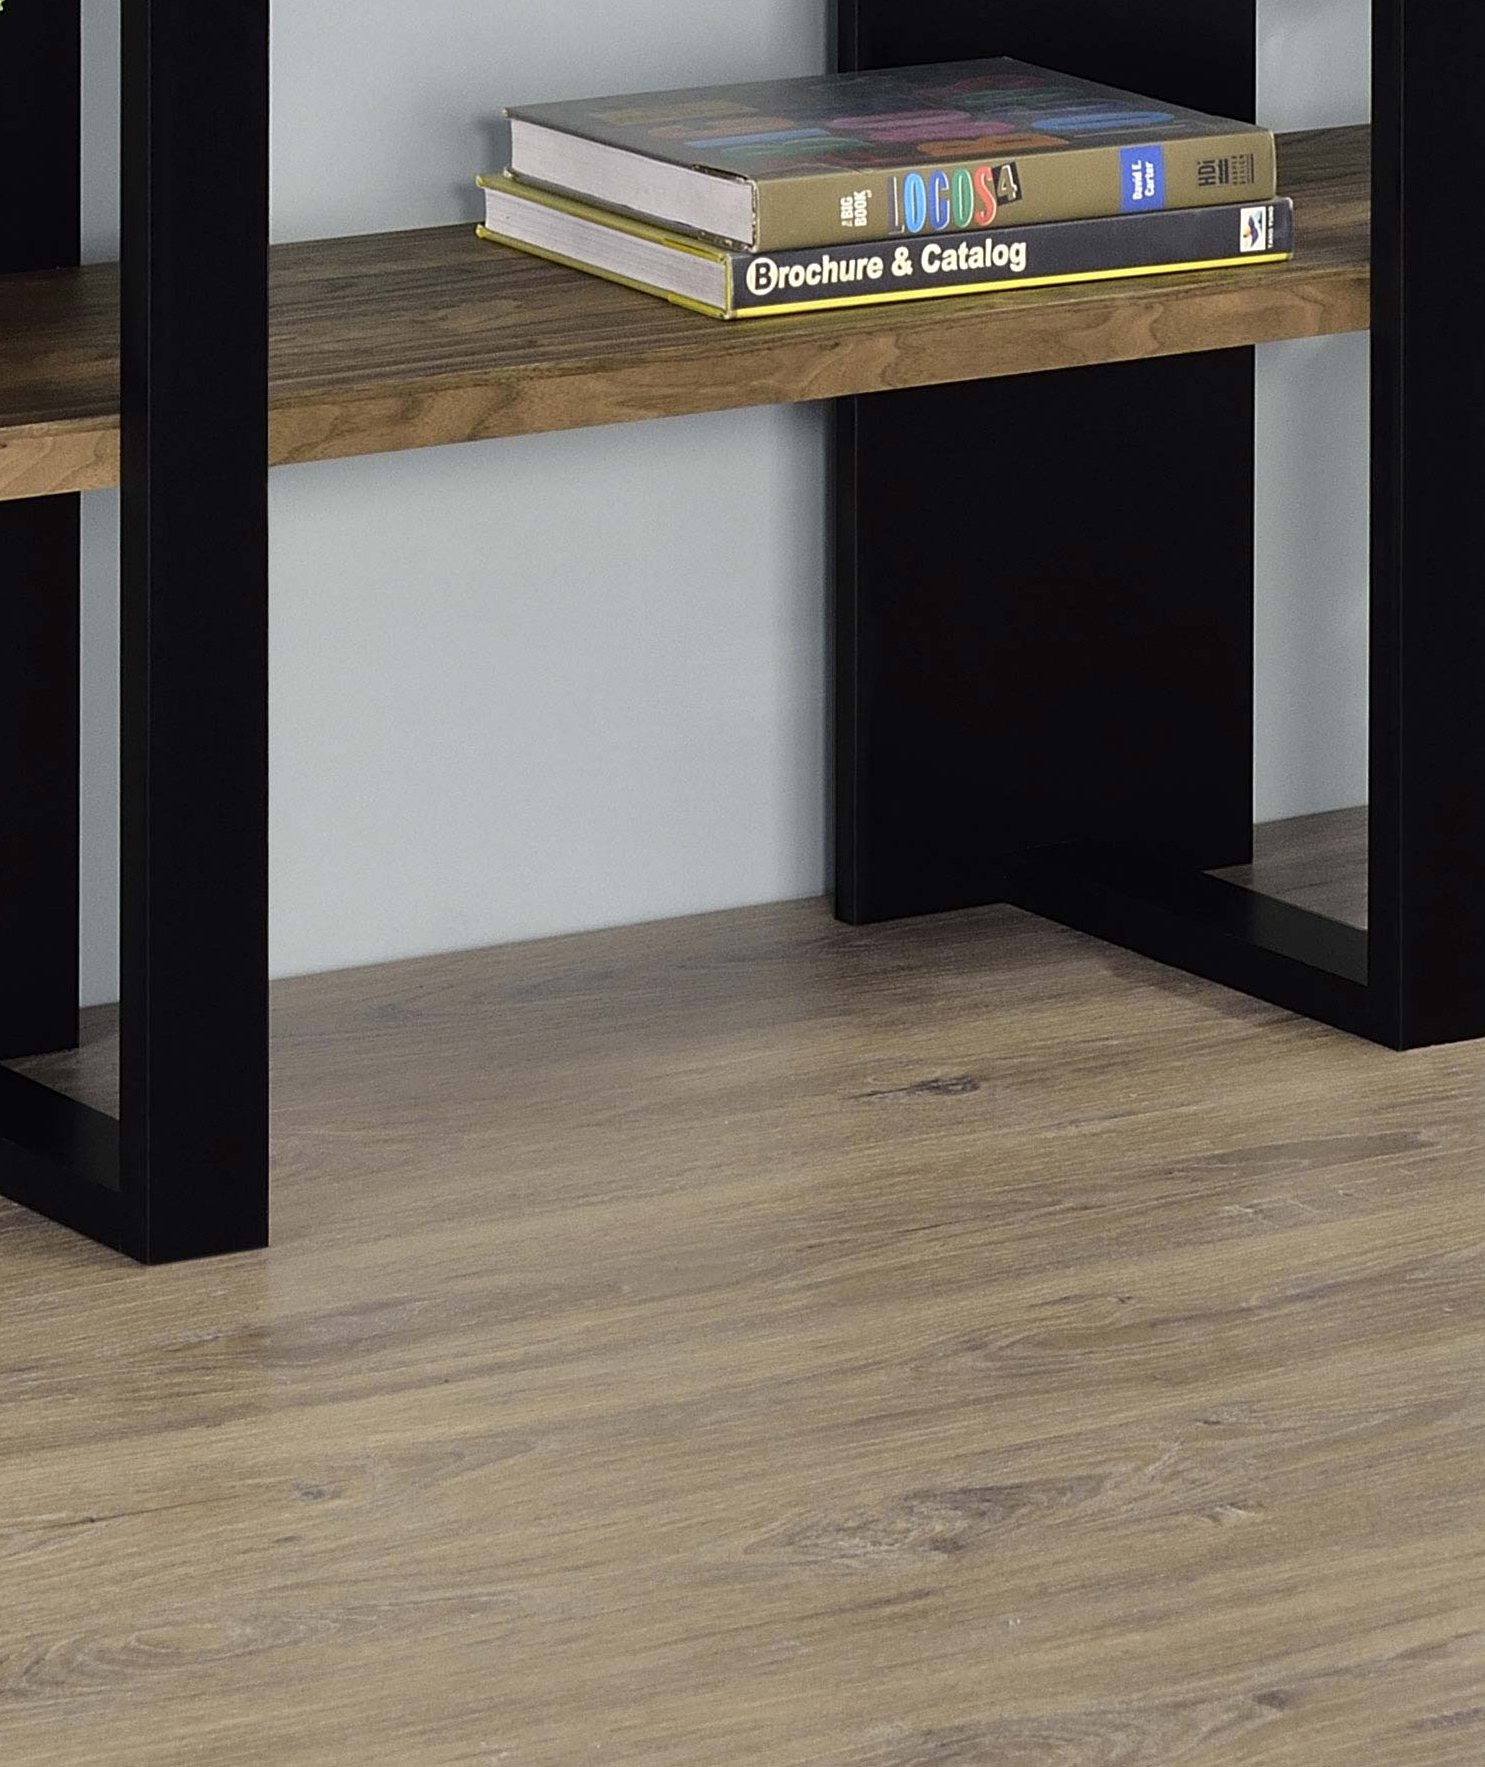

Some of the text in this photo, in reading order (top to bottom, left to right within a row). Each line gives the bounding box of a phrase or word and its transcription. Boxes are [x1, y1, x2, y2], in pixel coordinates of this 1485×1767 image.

[1132, 172, 1143, 200] David
[1144, 162, 1155, 196] Carter
[841, 196, 853, 219] BIG
[853, 191, 867, 227] BOOK
[746, 239, 1026, 296] Brochure & Catalog
